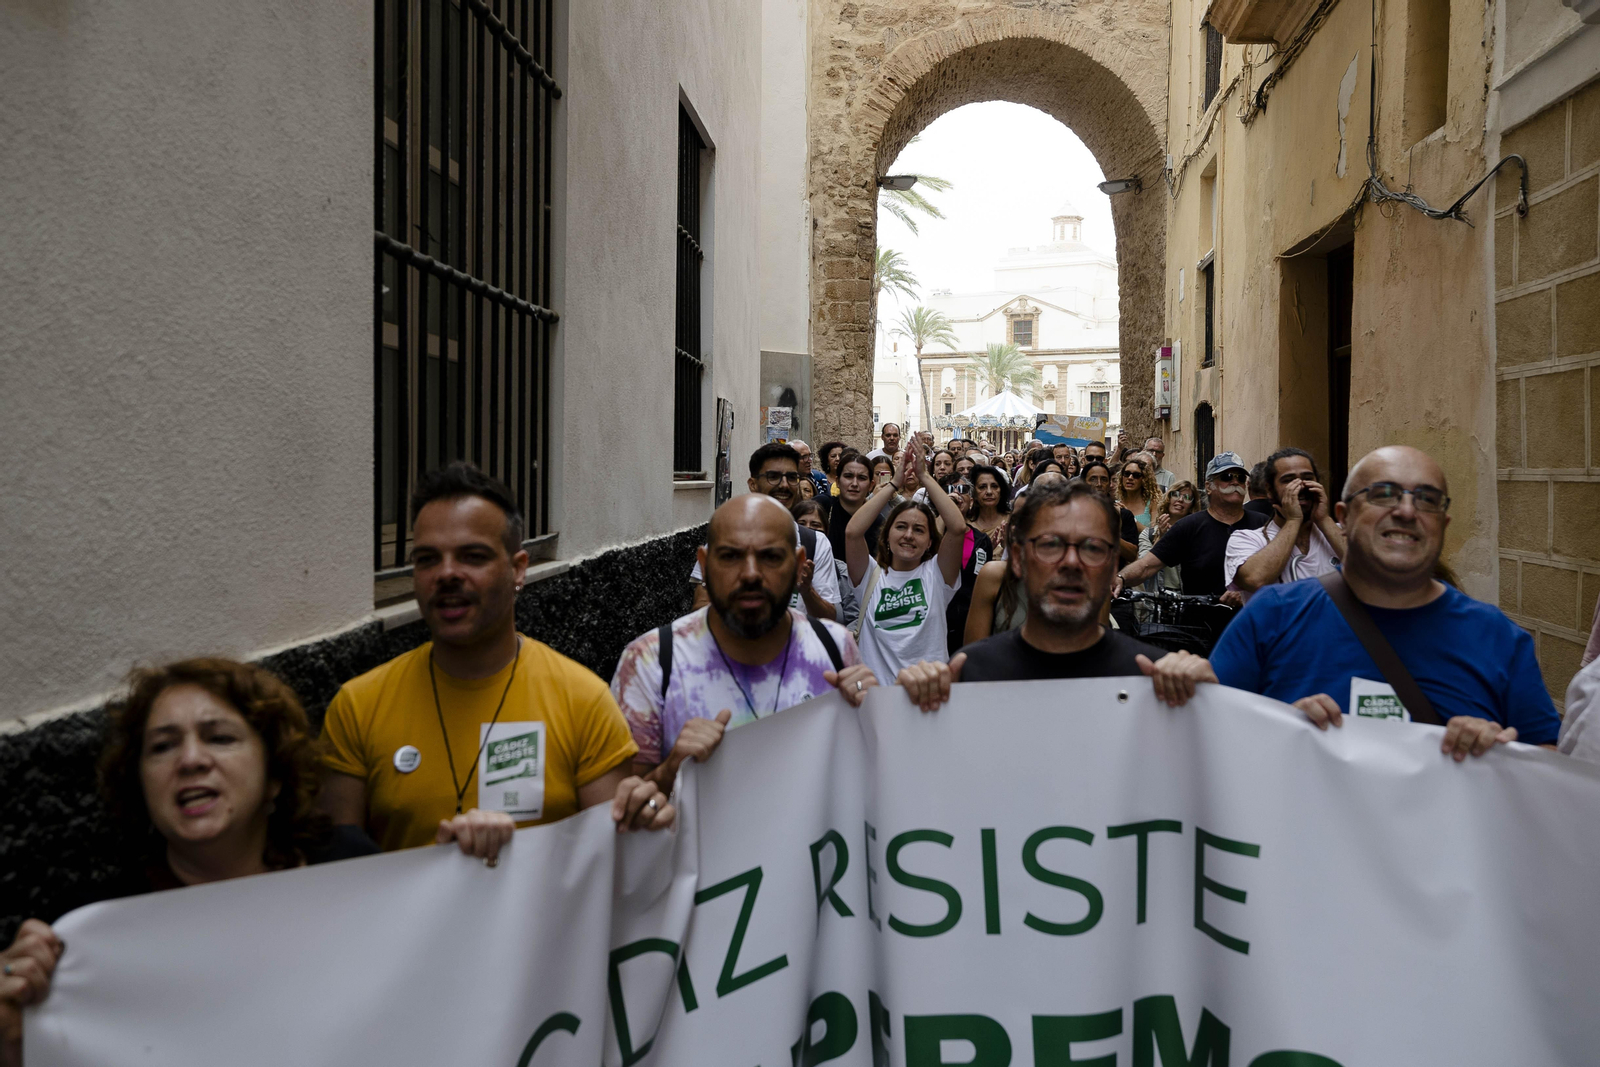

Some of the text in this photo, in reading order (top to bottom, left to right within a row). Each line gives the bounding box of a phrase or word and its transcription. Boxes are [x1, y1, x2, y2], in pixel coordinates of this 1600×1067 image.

[878, 593, 923, 612] RESISTE
[1359, 706, 1402, 715] RESISTE
[489, 744, 536, 765] RESISTE
[808, 819, 1261, 955] RESISTE
